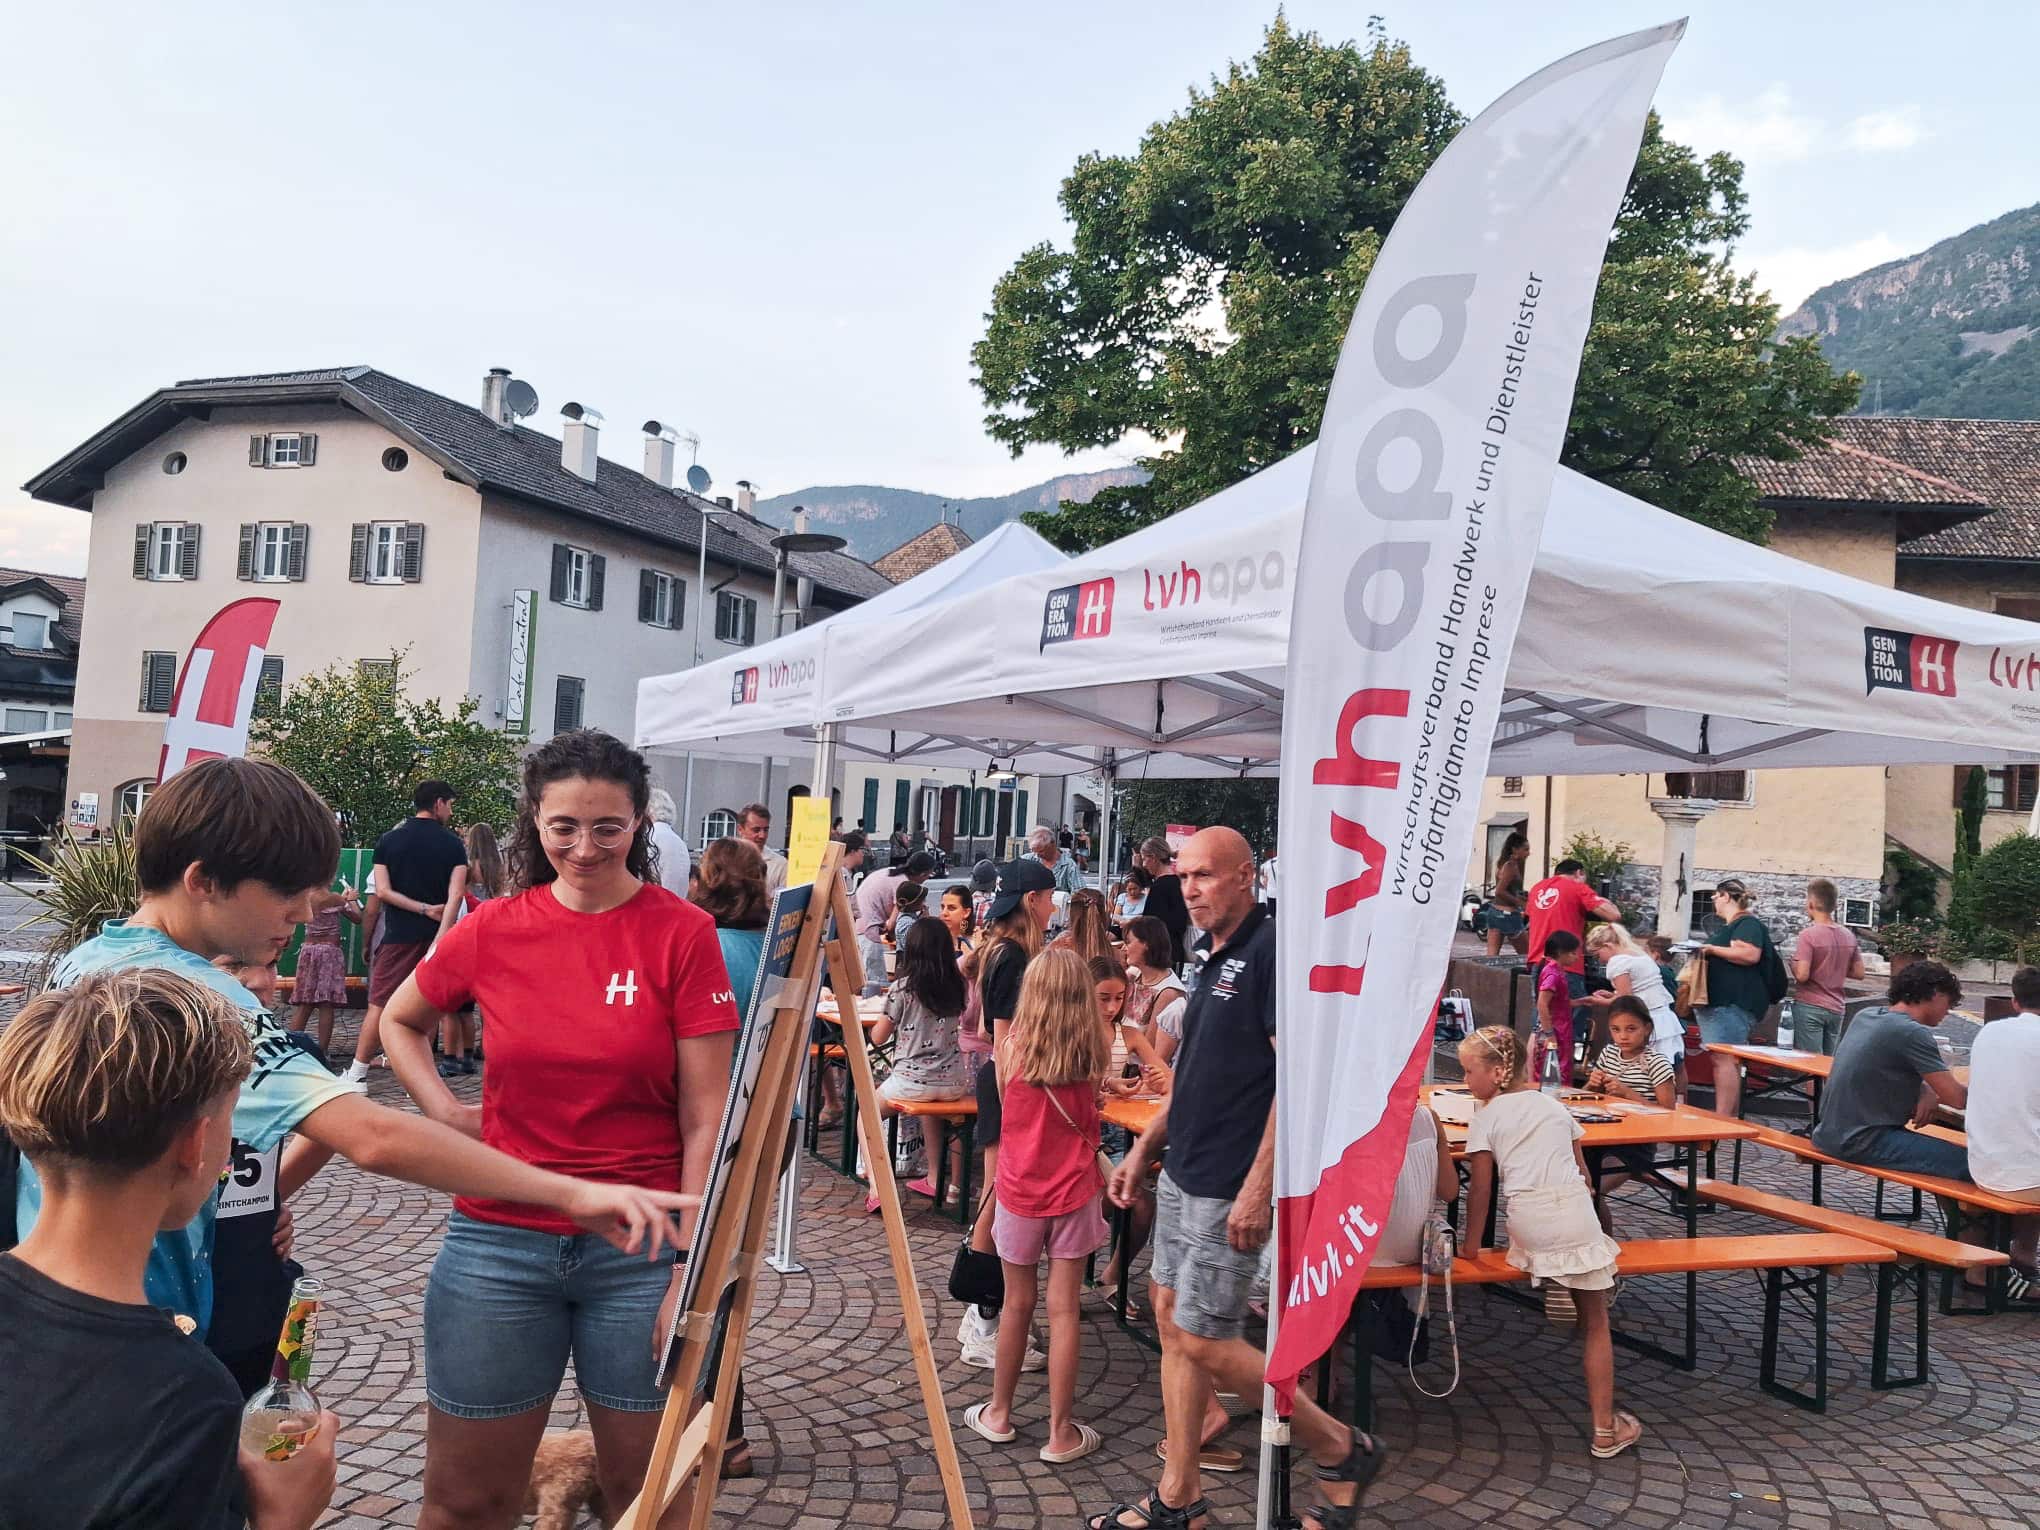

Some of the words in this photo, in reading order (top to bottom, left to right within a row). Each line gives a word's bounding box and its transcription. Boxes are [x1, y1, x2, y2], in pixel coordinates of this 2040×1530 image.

[1486, 271, 1544, 435] Dienstleister
[1476, 441, 1501, 492] und
[1440, 499, 1485, 637] Handwerk
[1048, 609, 1066, 624] ERA
[1049, 593, 1070, 609] GEN
[512, 595, 529, 665] Central
[1046, 621, 1070, 638] TION
[1872, 636, 1896, 653] GEN
[1872, 652, 1896, 667] ERA
[1872, 665, 1903, 684] TION
[1412, 698, 1475, 905] Confartigianato
[1461, 584, 1497, 692] Imprese
[1391, 641, 1455, 896] Wirtschaftsverband
[605, 969, 639, 1006] H
